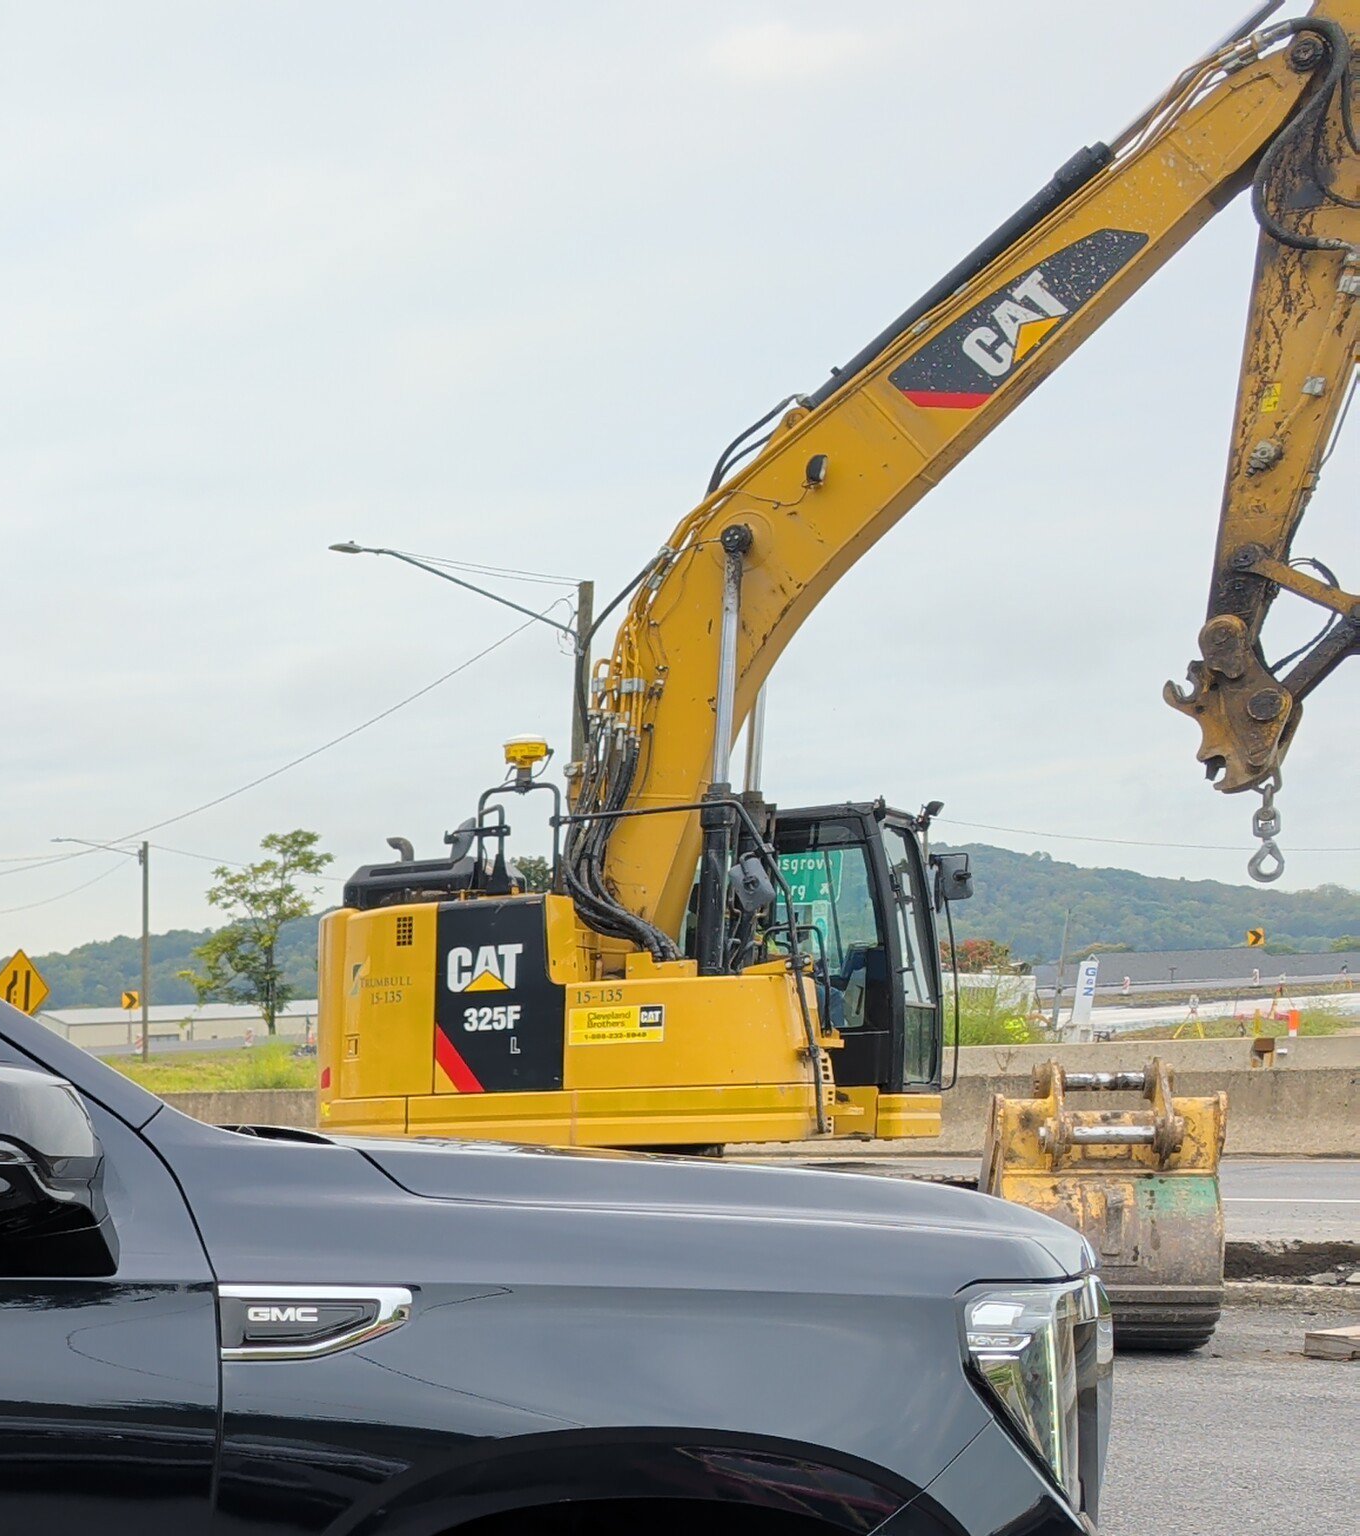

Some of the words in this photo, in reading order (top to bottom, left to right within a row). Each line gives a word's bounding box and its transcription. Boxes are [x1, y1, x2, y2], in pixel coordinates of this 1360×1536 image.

[962, 269, 1069, 376] CAT
[447, 943, 523, 993] CAT
[360, 976, 413, 988] TRUMBULL
[371, 990, 402, 1005] 15-135
[576, 988, 623, 1005] 15-135
[463, 1005, 522, 1032] 325F
[586, 1019, 626, 1029] Brothers
[587, 1011, 631, 1021] Cleveland
[640, 1010, 662, 1024] CAT
[509, 1036, 522, 1055] L
[247, 1307, 319, 1323] GMC
